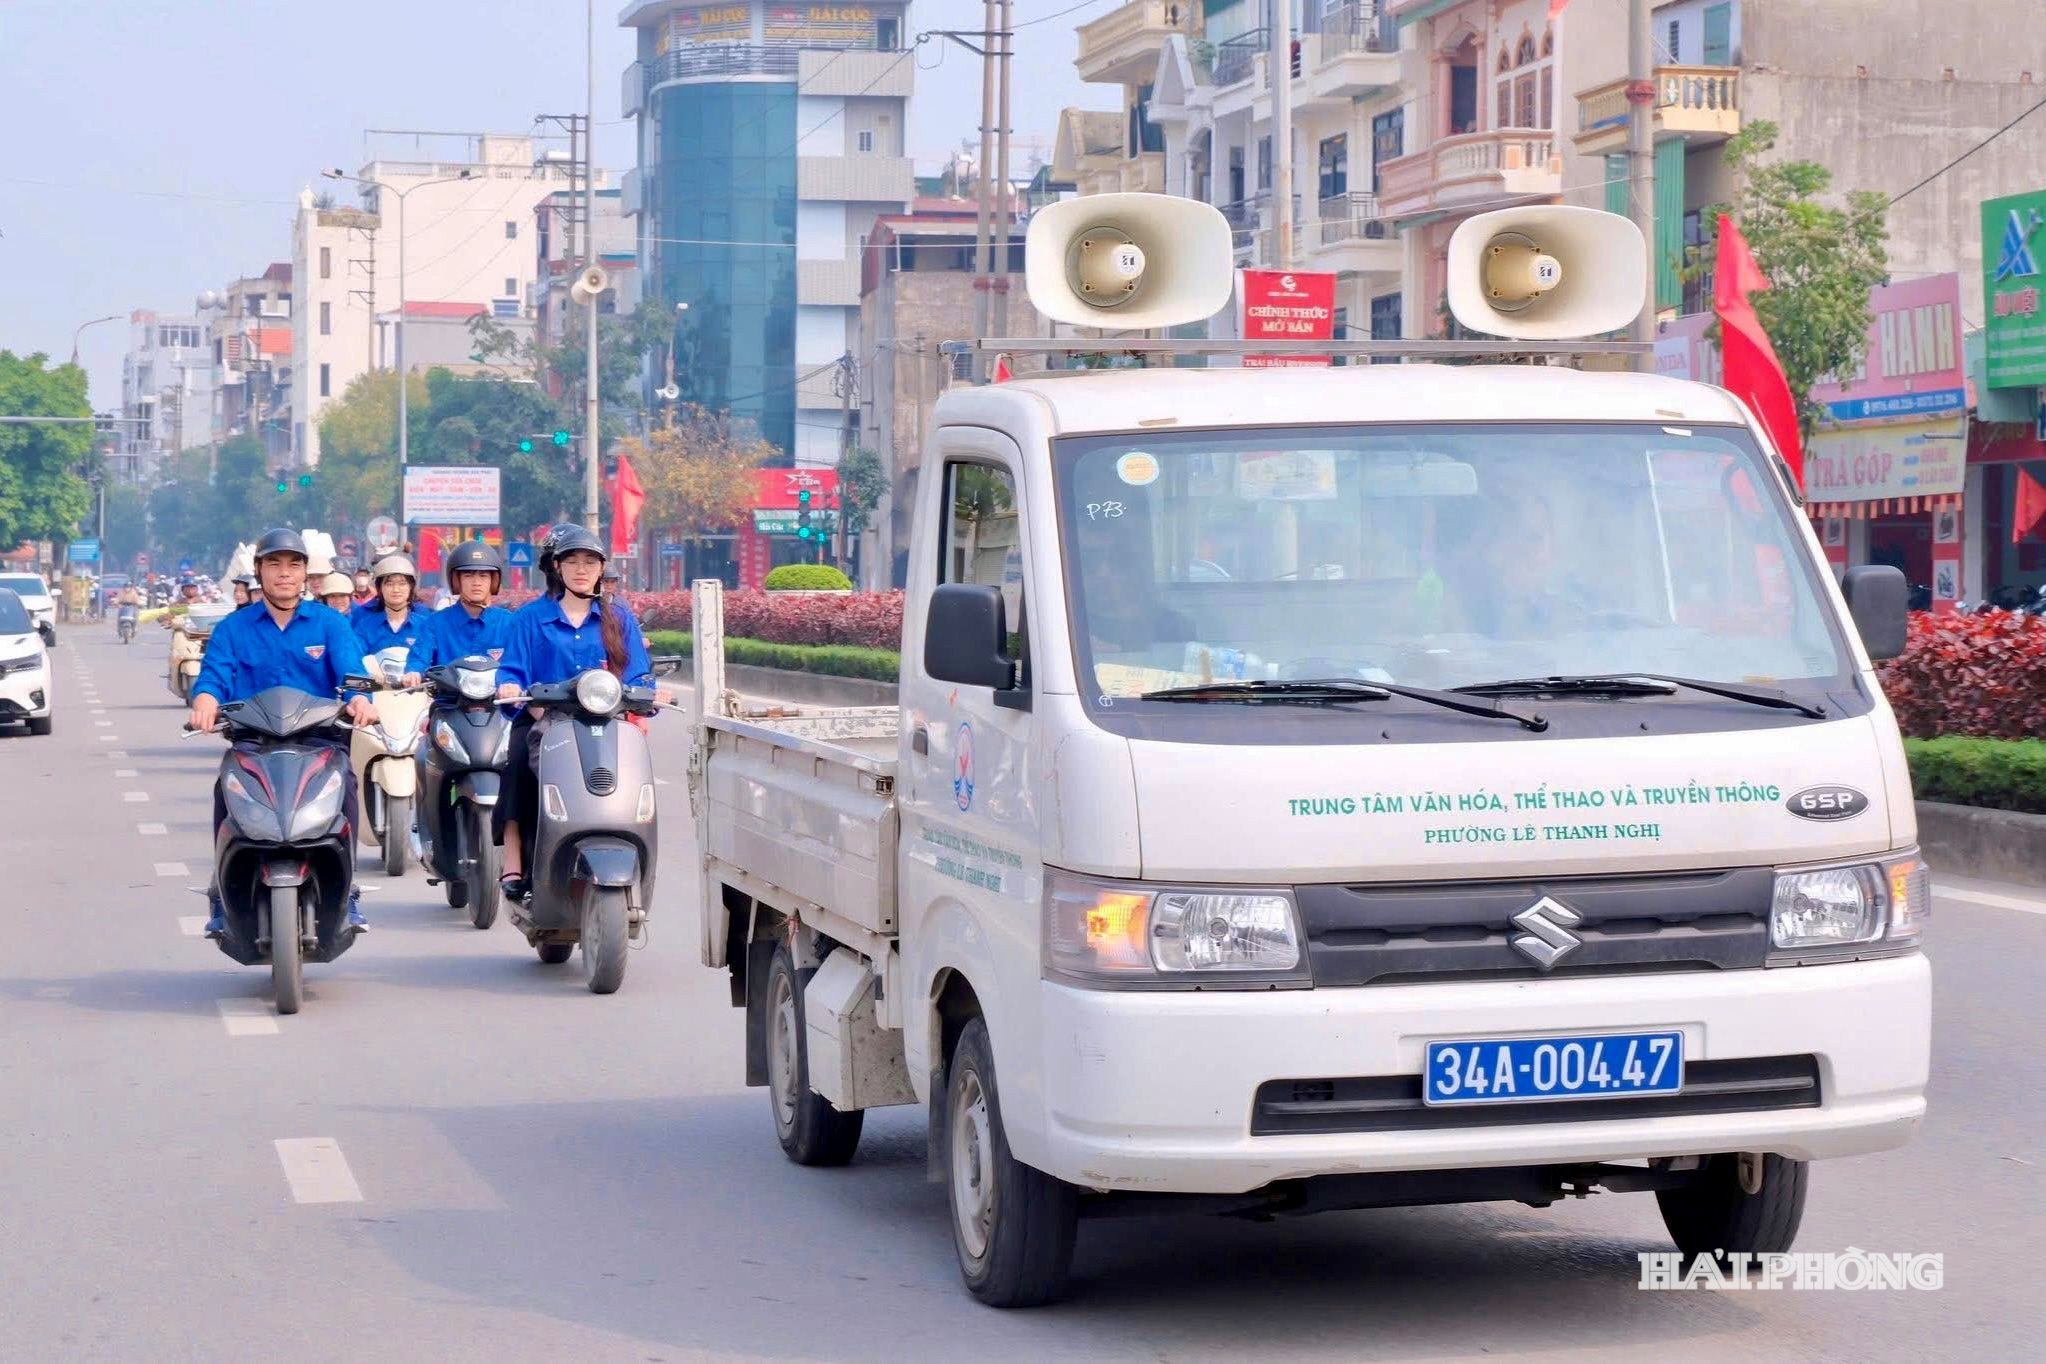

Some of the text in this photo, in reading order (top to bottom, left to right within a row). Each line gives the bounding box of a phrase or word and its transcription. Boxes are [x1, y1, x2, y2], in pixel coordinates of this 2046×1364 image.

[1248, 305, 1328, 319] CHÍNH THỨC
[1812, 443, 1847, 488] TRẢ
[1854, 445, 1893, 486] GÓP
[1289, 779, 1781, 816] TRUNG TÂM VĂN HÓA, THỂ THAO VÀ TRUYỀN THÔNG
[1800, 792, 1853, 810] GSP
[1424, 823, 1661, 844] PHƯỜNG LÊ THANH NGHỊ
[1436, 1038, 1675, 1096] 34A-004.47
